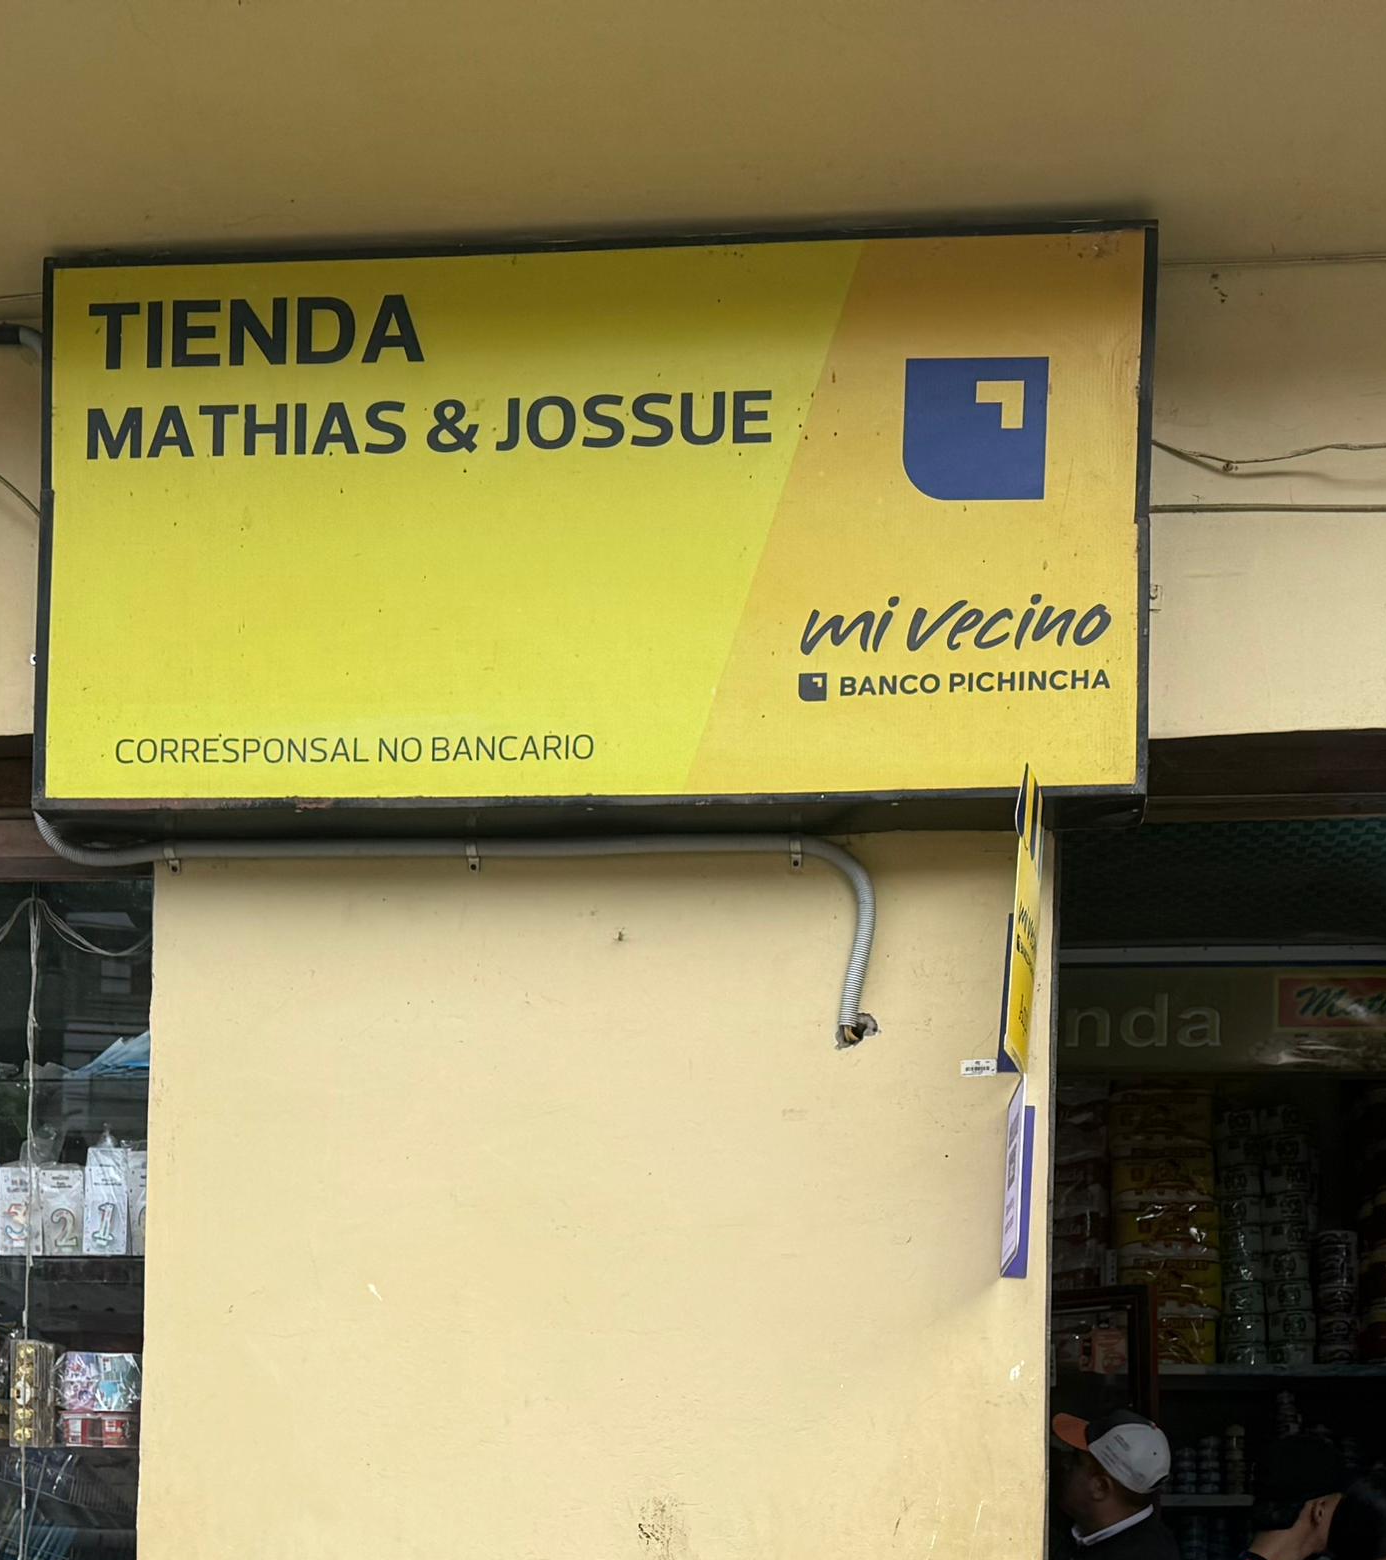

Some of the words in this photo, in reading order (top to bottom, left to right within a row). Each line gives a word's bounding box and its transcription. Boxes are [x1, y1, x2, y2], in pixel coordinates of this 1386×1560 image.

[89, 294, 424, 370] TIENDA
[86, 399, 406, 460] MATHIAS
[426, 398, 478, 453] &
[496, 390, 771, 451] JOSSUE
[800, 595, 898, 656] mi
[905, 597, 1110, 652] vecino
[839, 672, 940, 697] BANCO
[948, 668, 1110, 693] PICHINCHA
[114, 734, 370, 765] CORRESPONSAL
[376, 736, 423, 763] NO
[430, 732, 594, 761] BANCARIO
[51, 1208, 76, 1246] 2
